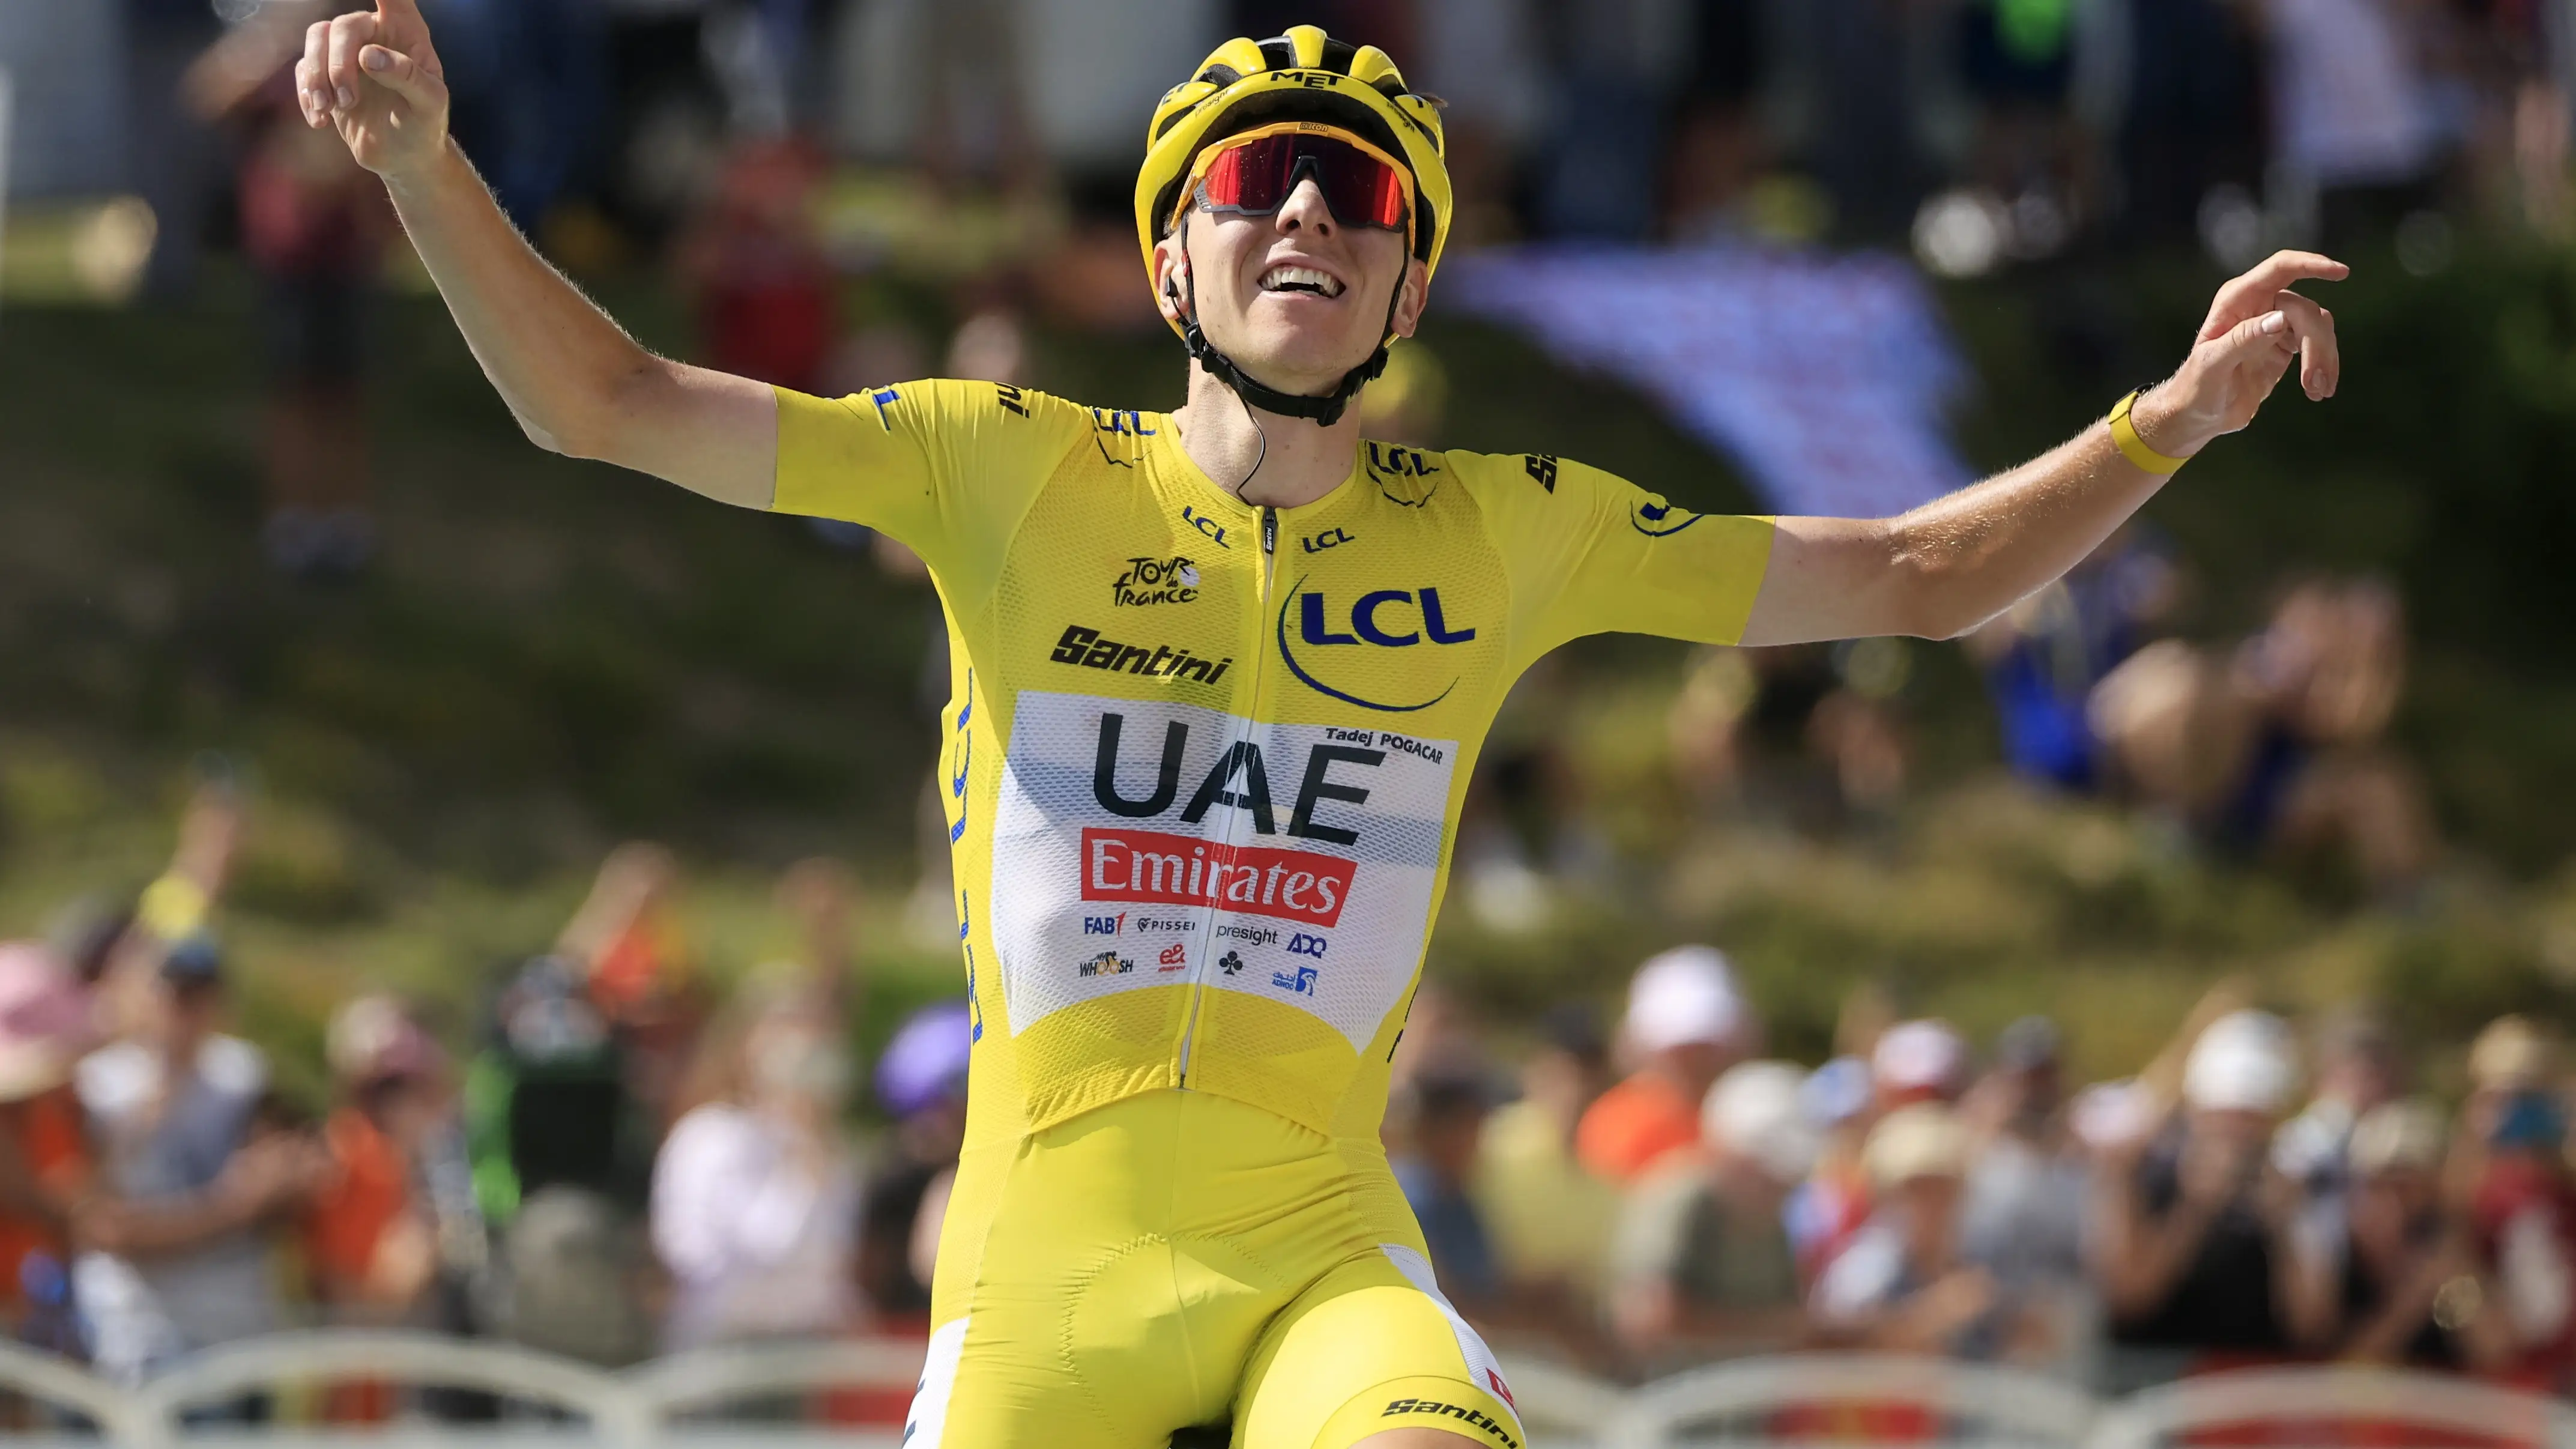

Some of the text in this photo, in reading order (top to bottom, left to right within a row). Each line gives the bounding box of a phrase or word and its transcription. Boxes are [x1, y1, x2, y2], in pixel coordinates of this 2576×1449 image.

[1271, 71, 1344, 89] MET
[1369, 441, 1439, 476] LCL
[1182, 506, 1230, 549] LCL
[1302, 527, 1355, 553] LCL
[1301, 587, 1475, 647] LCL
[1050, 625, 1233, 685] Santini
[1326, 728, 1443, 764] Tadej POGACAR
[1093, 712, 1386, 846] UAE
[1090, 838, 1341, 914] Emirates
[1151, 921, 1196, 931] PISSEI
[1216, 925, 1278, 946] presight
[1286, 933, 1327, 958] ADQ
[1381, 1399, 1518, 1449] Santini
